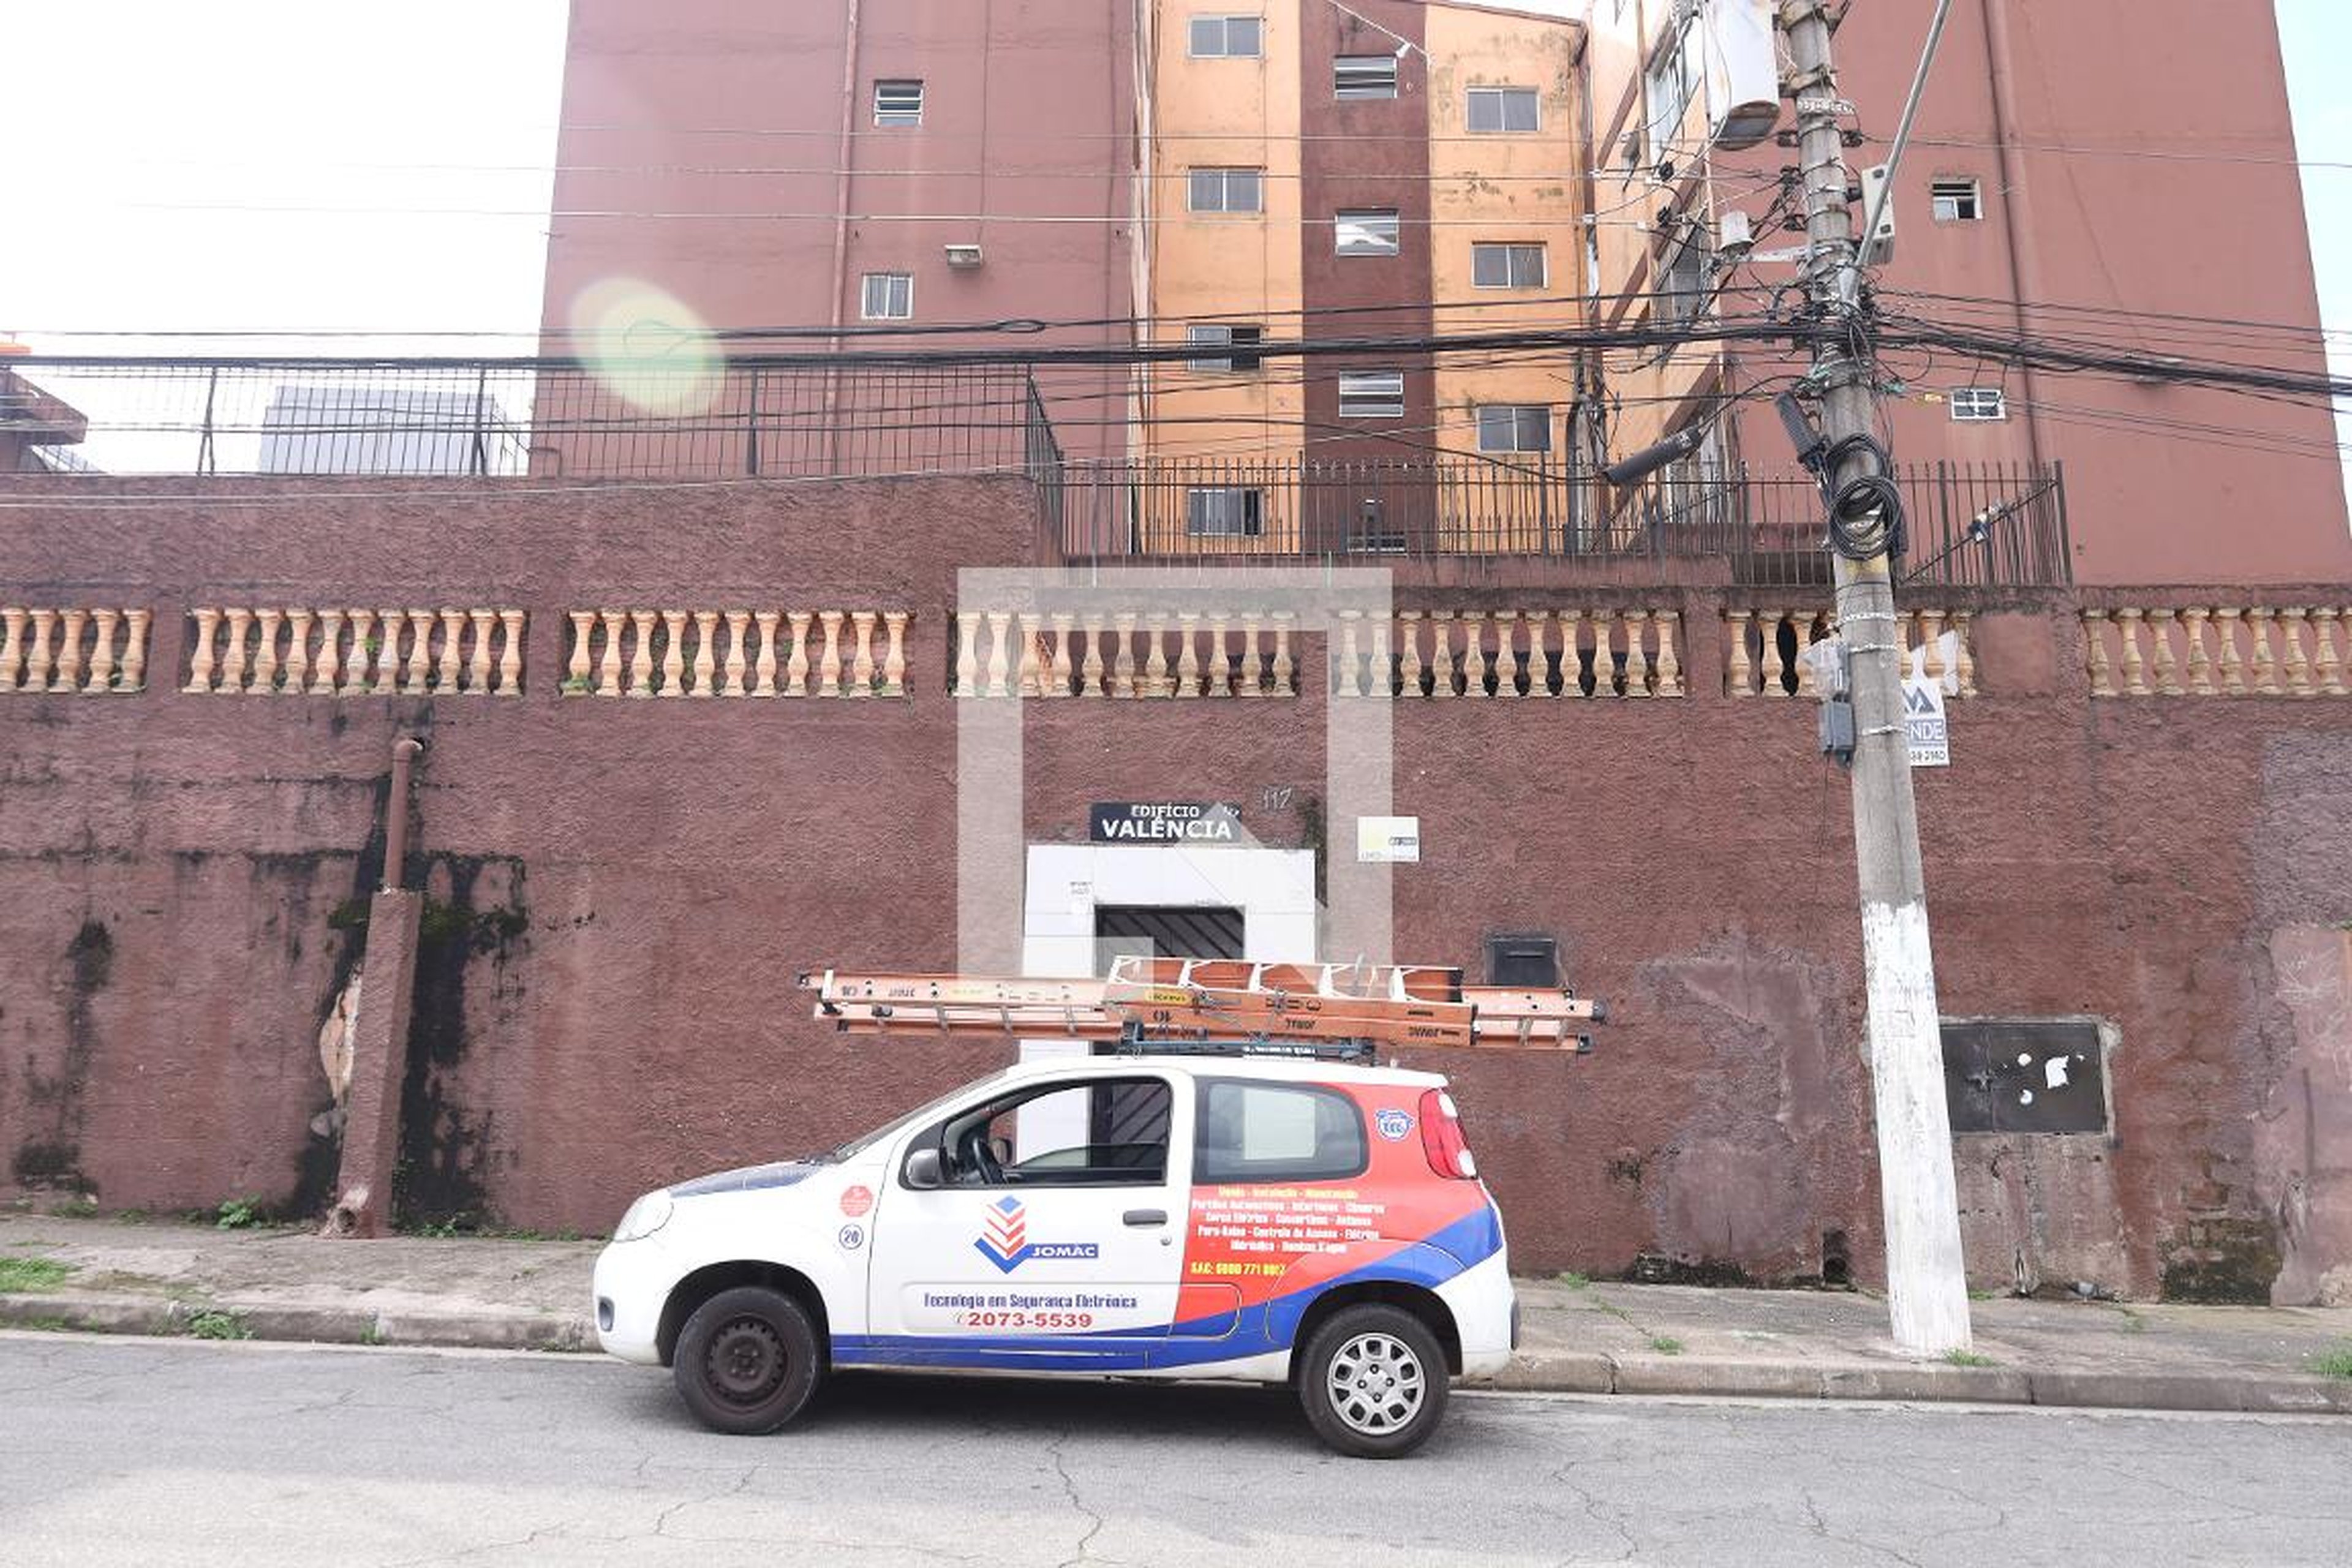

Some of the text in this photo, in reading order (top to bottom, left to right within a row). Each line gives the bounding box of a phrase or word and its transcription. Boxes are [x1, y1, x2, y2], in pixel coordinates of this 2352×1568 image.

[1130, 802, 1199, 818] EDIFÍCIO
[1102, 816, 1233, 839] VALÊNCIA
[1032, 1246, 1096, 1257] JOMAC
[924, 1292, 1138, 1310] Tecnologia em Segurança Eletrônica
[968, 1312, 1093, 1328] 2073-5539
